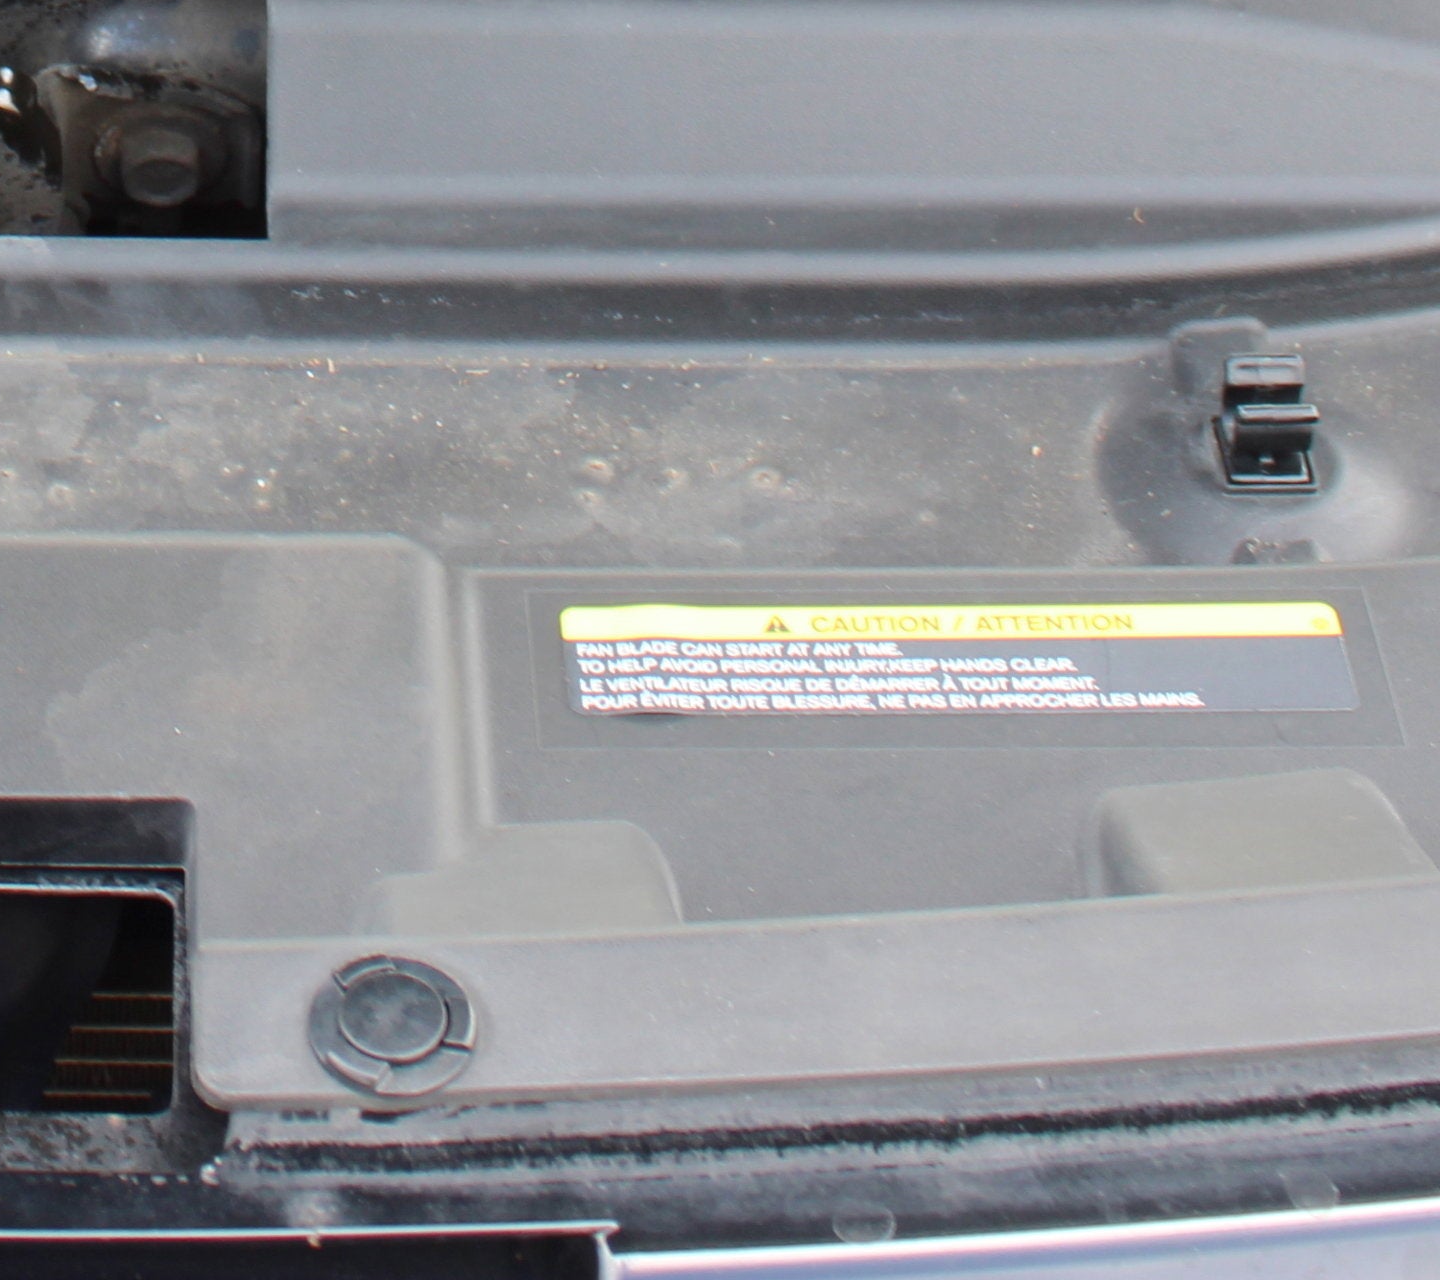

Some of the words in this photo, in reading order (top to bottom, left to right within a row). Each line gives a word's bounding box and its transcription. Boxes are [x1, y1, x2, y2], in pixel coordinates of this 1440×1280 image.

[810, 615, 941, 632] CAUTION
[976, 614, 1136, 632] ATTENTION
[575, 642, 615, 658] FAN
[616, 640, 680, 657] BLADE
[681, 641, 723, 658] CAN
[725, 641, 785, 658] START
[787, 641, 811, 657] AT
[812, 641, 854, 657] ANY
[854, 641, 904, 657] TIME.
[577, 658, 606, 675] TO
[607, 657, 659, 674] HELP
[660, 657, 719, 674] AVOID
[720, 658, 823, 675] PERSONAL
[940, 657, 1009, 674] HANDS
[1009, 656, 1078, 673] CLEAR.
[579, 677, 606, 694] LE
[606, 675, 730, 694] VENTILATEUR
[730, 678, 804, 694] RISQUE
[805, 677, 834, 694] DE
[958, 676, 1010, 692] TOUT
[1011, 675, 1101, 692] MOMENT.
[581, 694, 638, 711] POUR
[707, 694, 770, 711] TOUTE
[878, 694, 908, 710] NE
[908, 694, 948, 710] PAS
[948, 693, 978, 710] EN
[980, 693, 1101, 709] APPROCHER
[1101, 692, 1138, 708] LES
